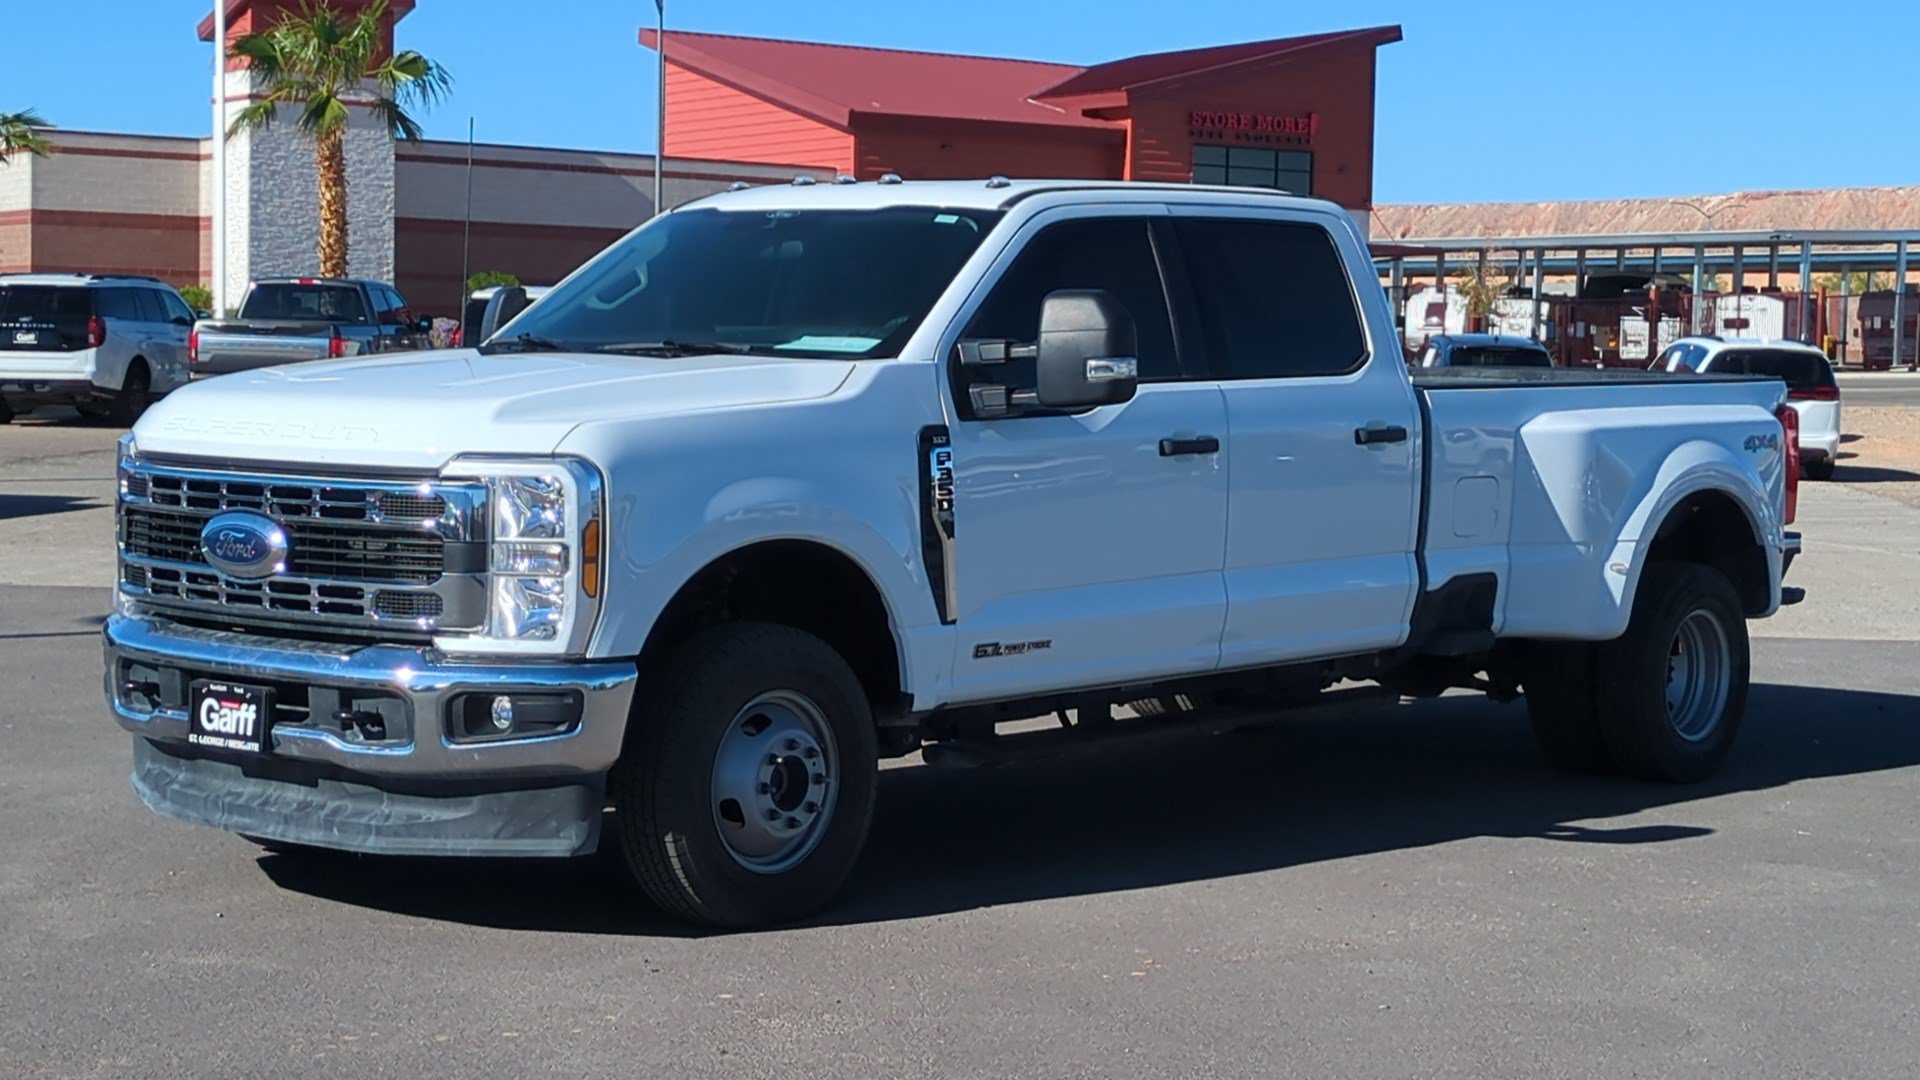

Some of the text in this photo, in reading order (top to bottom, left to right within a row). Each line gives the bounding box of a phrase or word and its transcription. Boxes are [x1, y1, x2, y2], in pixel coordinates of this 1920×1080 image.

[1191, 111, 1250, 130] STORE
[280, 423, 380, 442] DUTY
[216, 529, 255, 559] Ford
[200, 697, 257, 736] Garff
